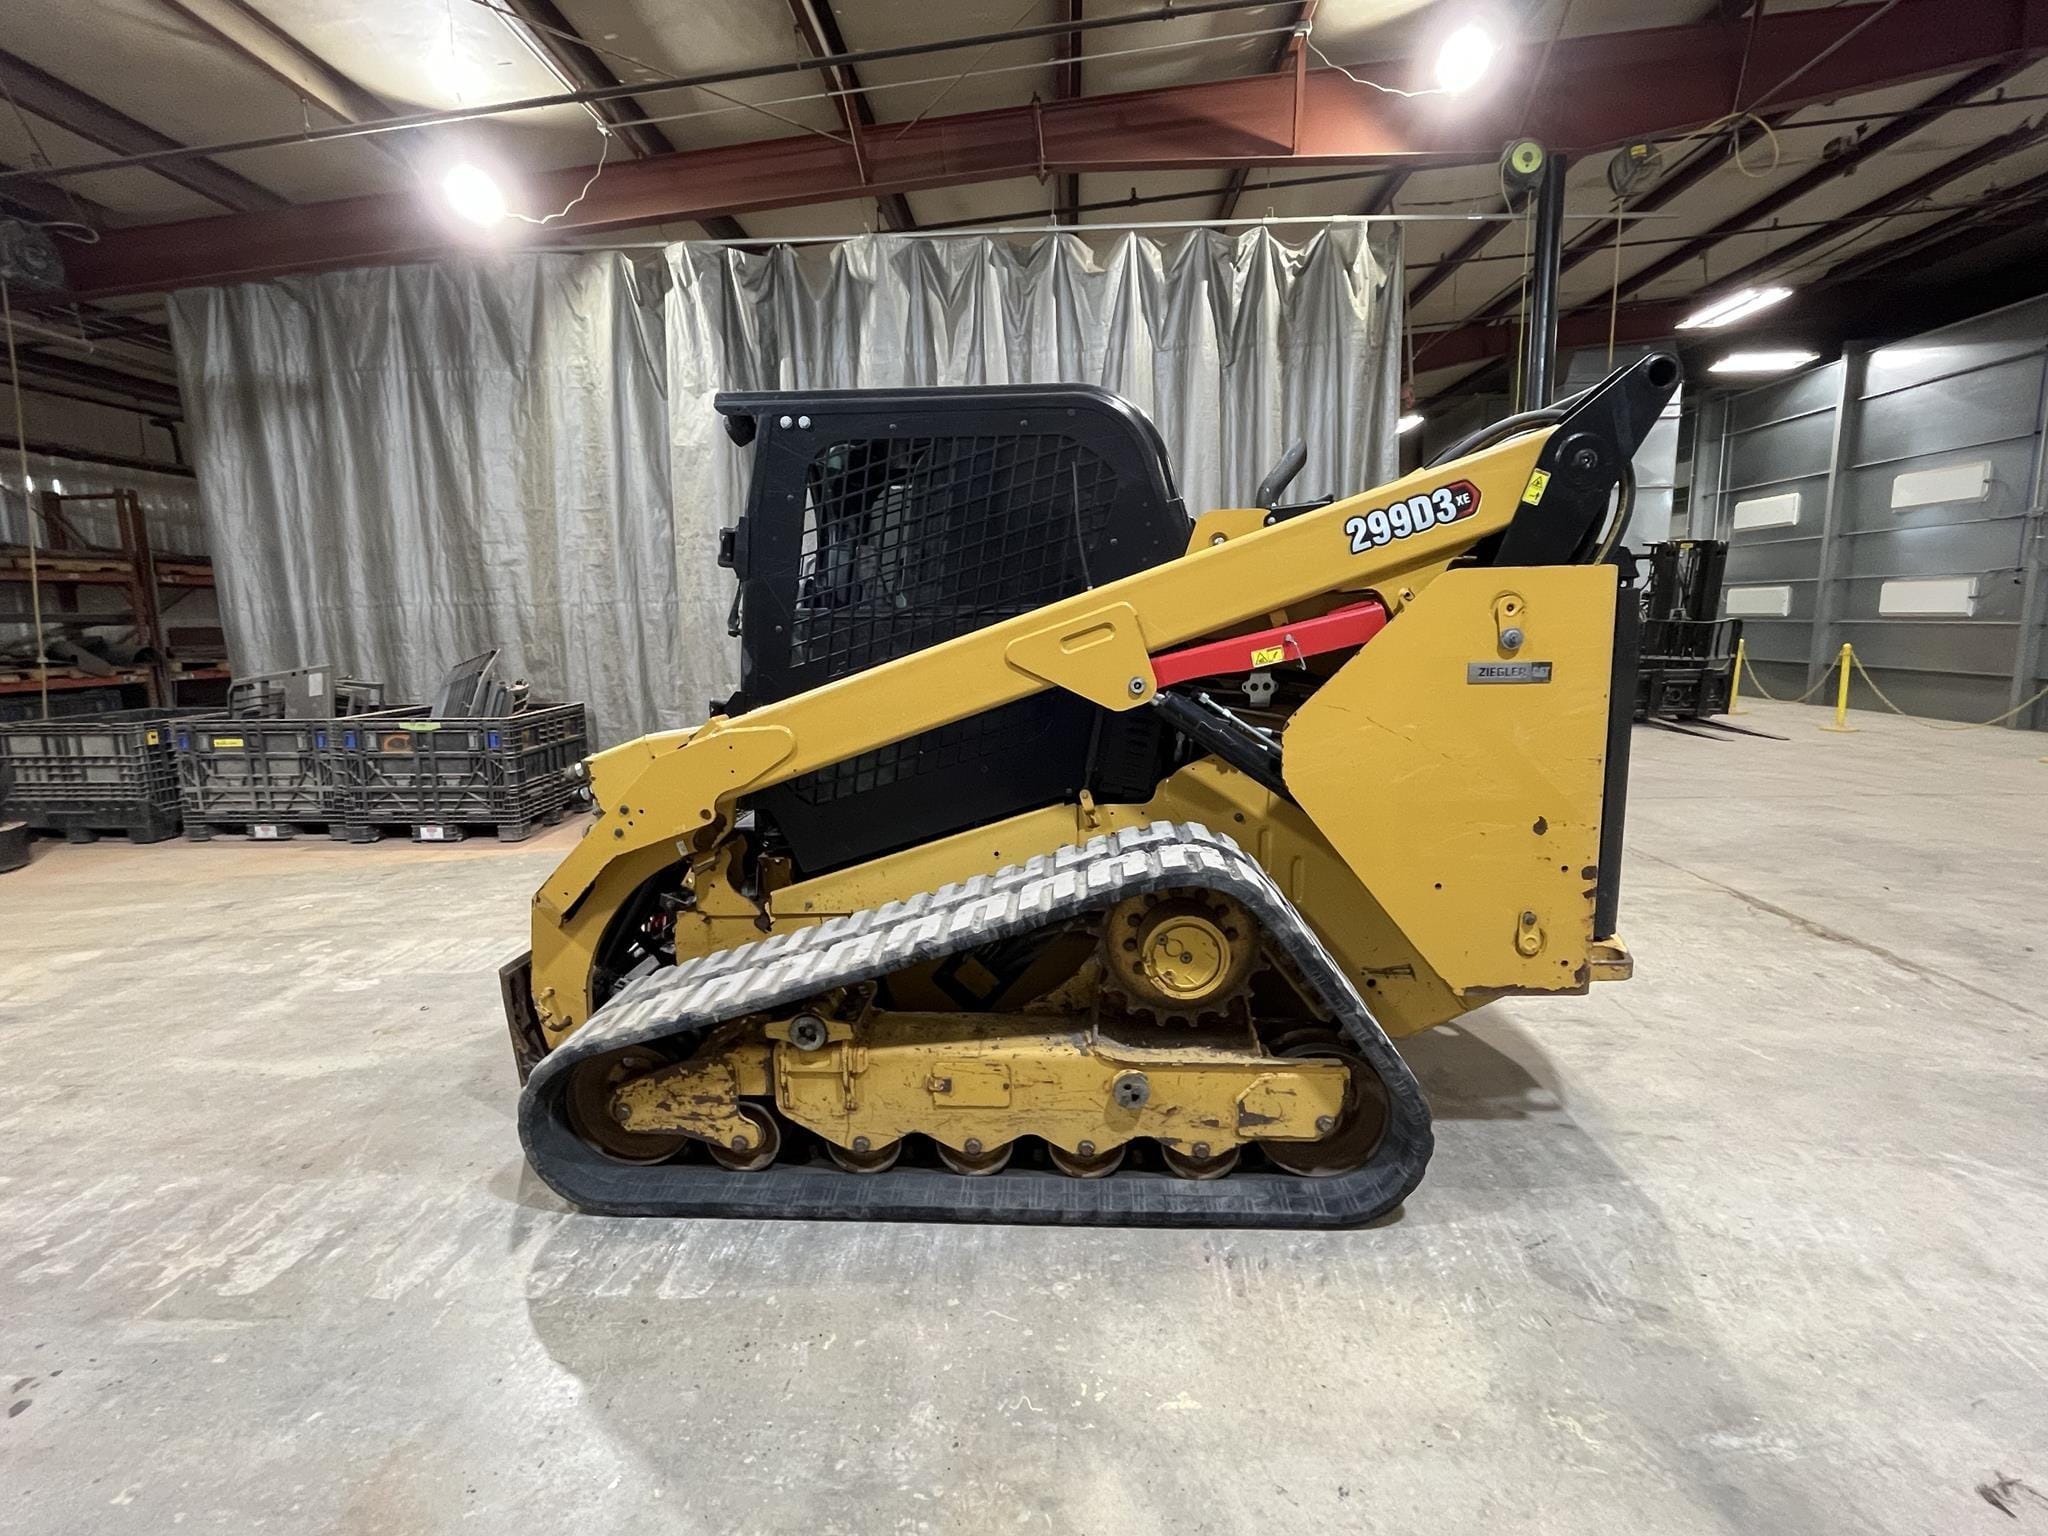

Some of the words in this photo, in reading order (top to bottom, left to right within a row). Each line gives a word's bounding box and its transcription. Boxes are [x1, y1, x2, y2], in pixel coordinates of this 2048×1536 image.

[1345, 487, 1457, 553] 299D3
[1455, 492, 1471, 507] XE
[1478, 667, 1528, 678] ZIEGLER
